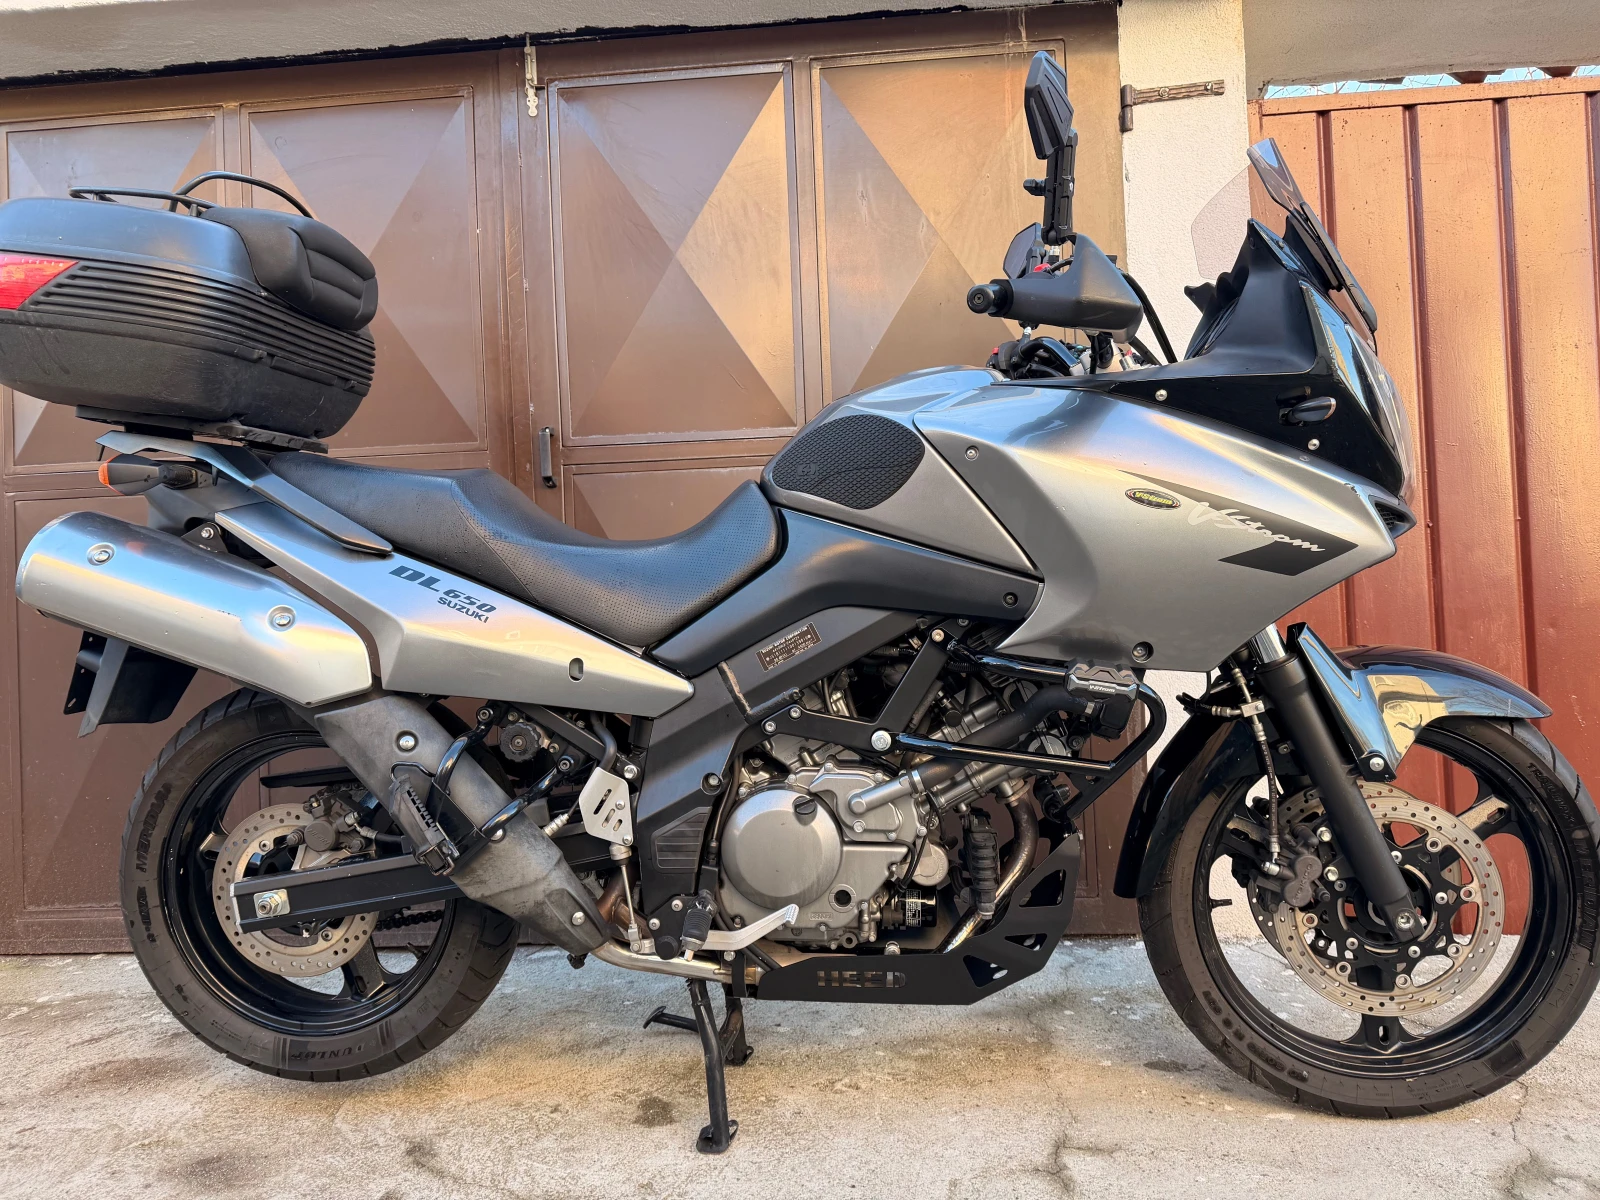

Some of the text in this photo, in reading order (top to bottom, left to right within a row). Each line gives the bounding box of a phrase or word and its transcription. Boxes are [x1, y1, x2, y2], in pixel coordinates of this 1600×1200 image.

[436, 596, 490, 624] SUZUKI
[816, 970, 907, 988] HEED
[290, 1043, 366, 1060] DUNLOP
